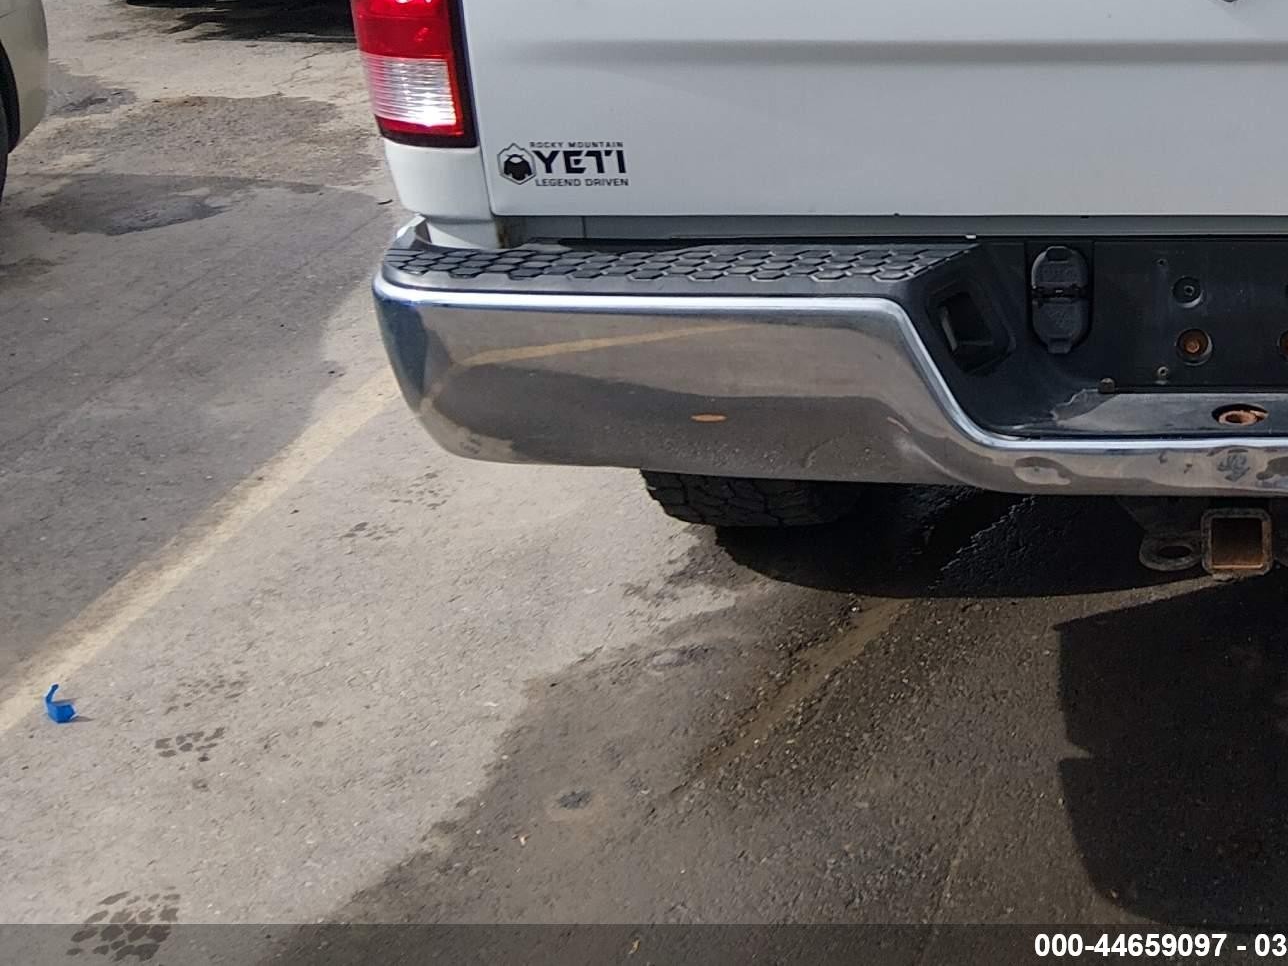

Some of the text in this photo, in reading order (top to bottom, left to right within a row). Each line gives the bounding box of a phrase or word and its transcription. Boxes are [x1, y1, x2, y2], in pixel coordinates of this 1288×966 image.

[532, 150, 627, 174] YETI
[535, 178, 629, 187] LEGEND DRIVEN
